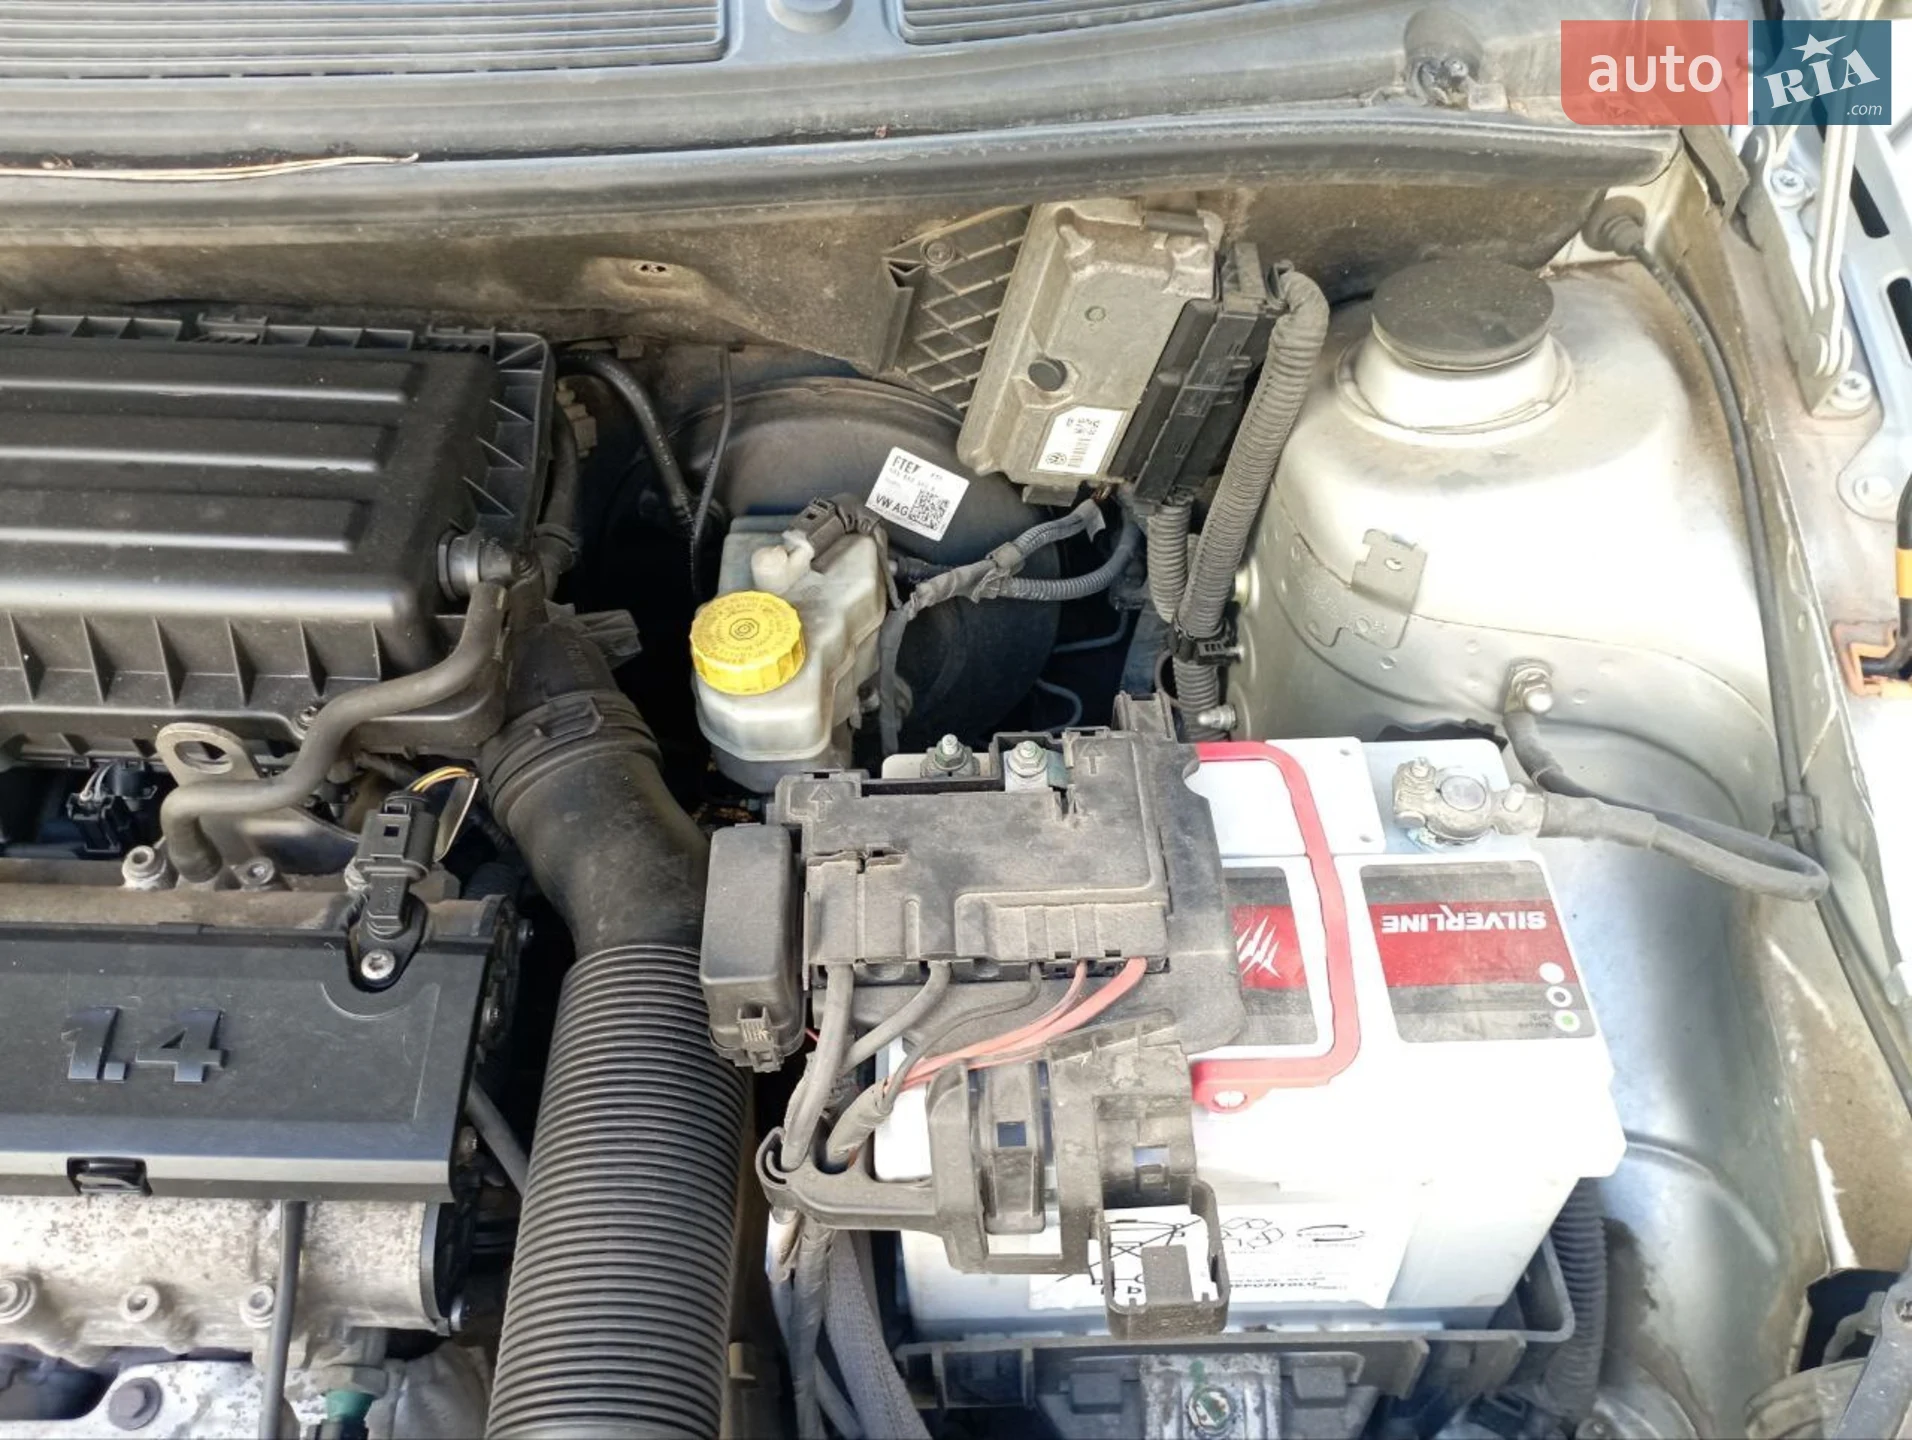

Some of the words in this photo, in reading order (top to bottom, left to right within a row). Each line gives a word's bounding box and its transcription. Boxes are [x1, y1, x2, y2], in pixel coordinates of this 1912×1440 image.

[875, 493, 893, 508] VW
[892, 502, 909, 516] AG
[1381, 904, 1547, 934] SILVERLINE
[61, 1005, 226, 1083] 1.4
